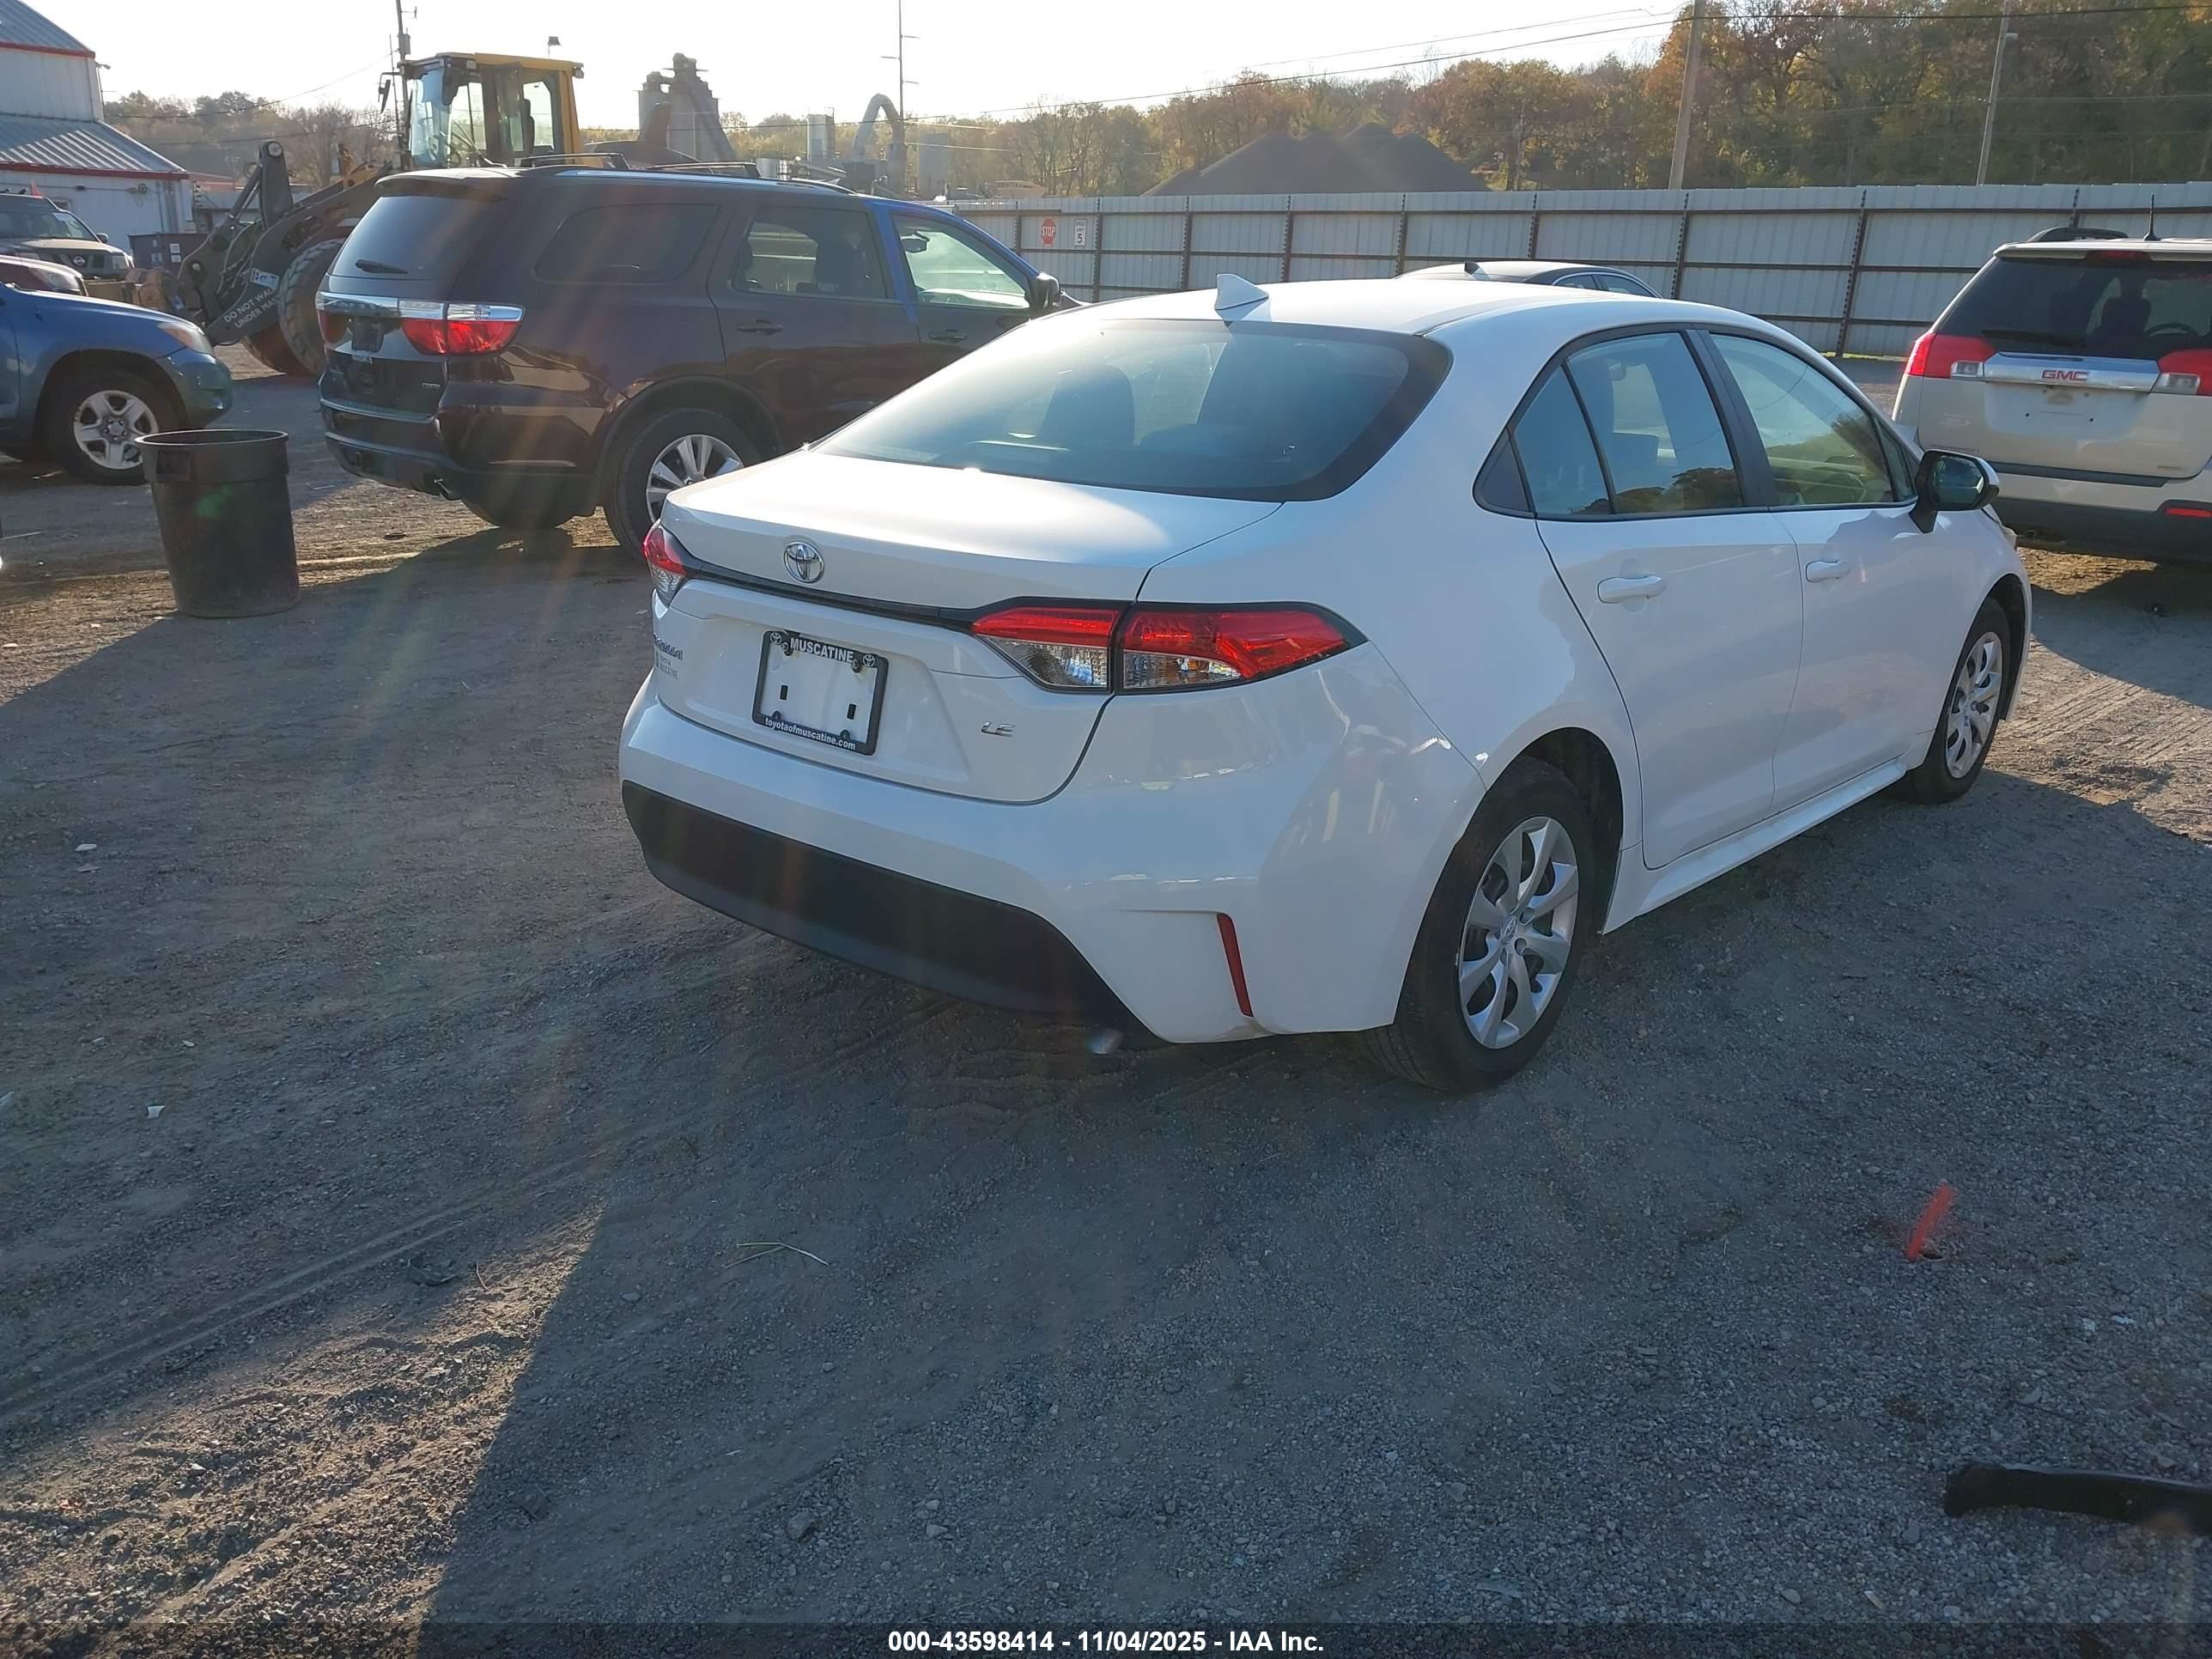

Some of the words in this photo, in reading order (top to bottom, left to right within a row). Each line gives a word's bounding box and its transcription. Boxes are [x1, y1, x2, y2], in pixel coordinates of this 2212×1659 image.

[1041, 226, 1056, 236] STOP
[1077, 234, 1083, 243] 5
[223, 311, 237, 323] DO
[237, 298, 255, 314] NOT
[254, 288, 276, 302] WAL
[234, 307, 263, 328] UNDER
[2041, 369, 2088, 380] GMC
[790, 637, 854, 663] MUSCATINE
[765, 717, 856, 750] toyotaofmuscatine.com
[981, 721, 1016, 738] LE
